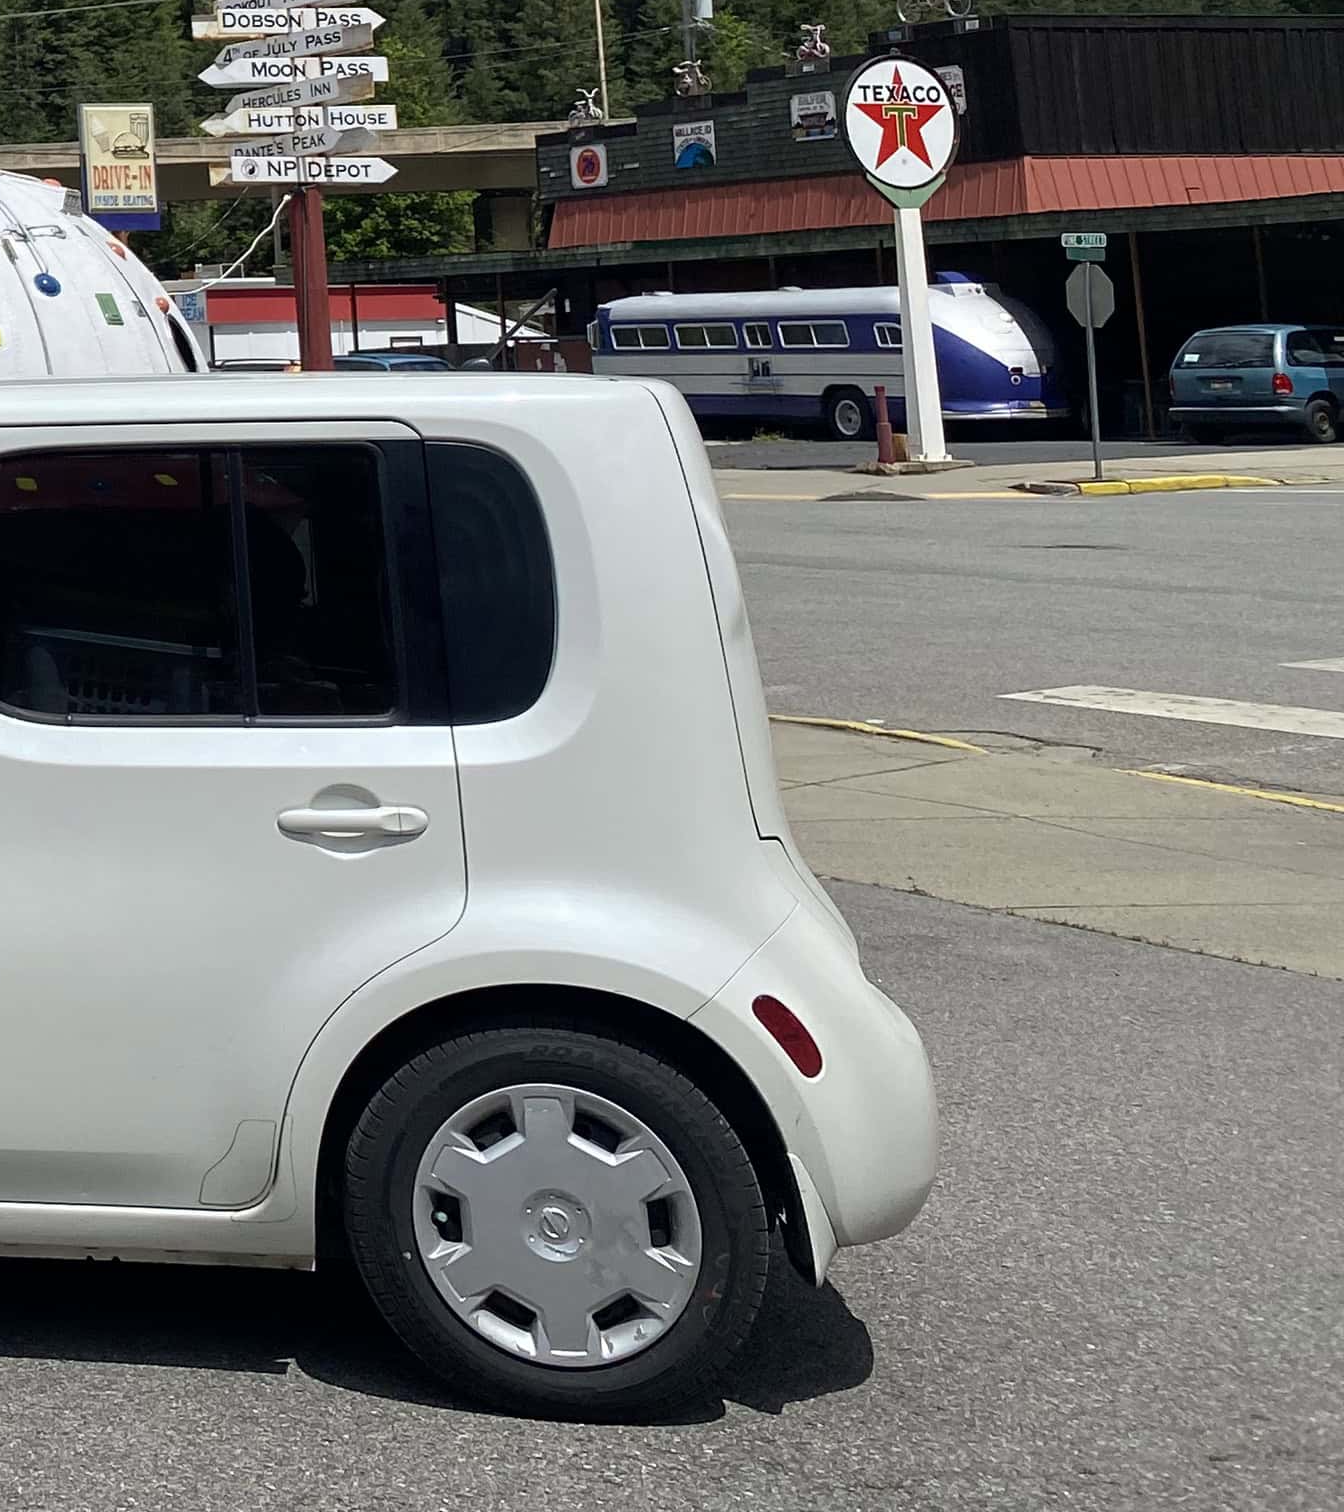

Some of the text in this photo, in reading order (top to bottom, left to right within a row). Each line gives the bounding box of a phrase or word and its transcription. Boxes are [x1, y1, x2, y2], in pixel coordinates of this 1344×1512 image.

[222, 12, 361, 28] DOBSON PASS
[263, 40, 297, 56] JULY
[305, 32, 341, 48] PASS
[251, 62, 370, 78] MOON PASS
[242, 82, 331, 108] HERCULES INN
[858, 85, 940, 102] TEXACO
[248, 112, 388, 128] HUTTON HOUSE
[292, 133, 326, 151] PEAK
[93, 165, 152, 190] DRIVE-IN
[267, 161, 371, 178] NP DEPOT
